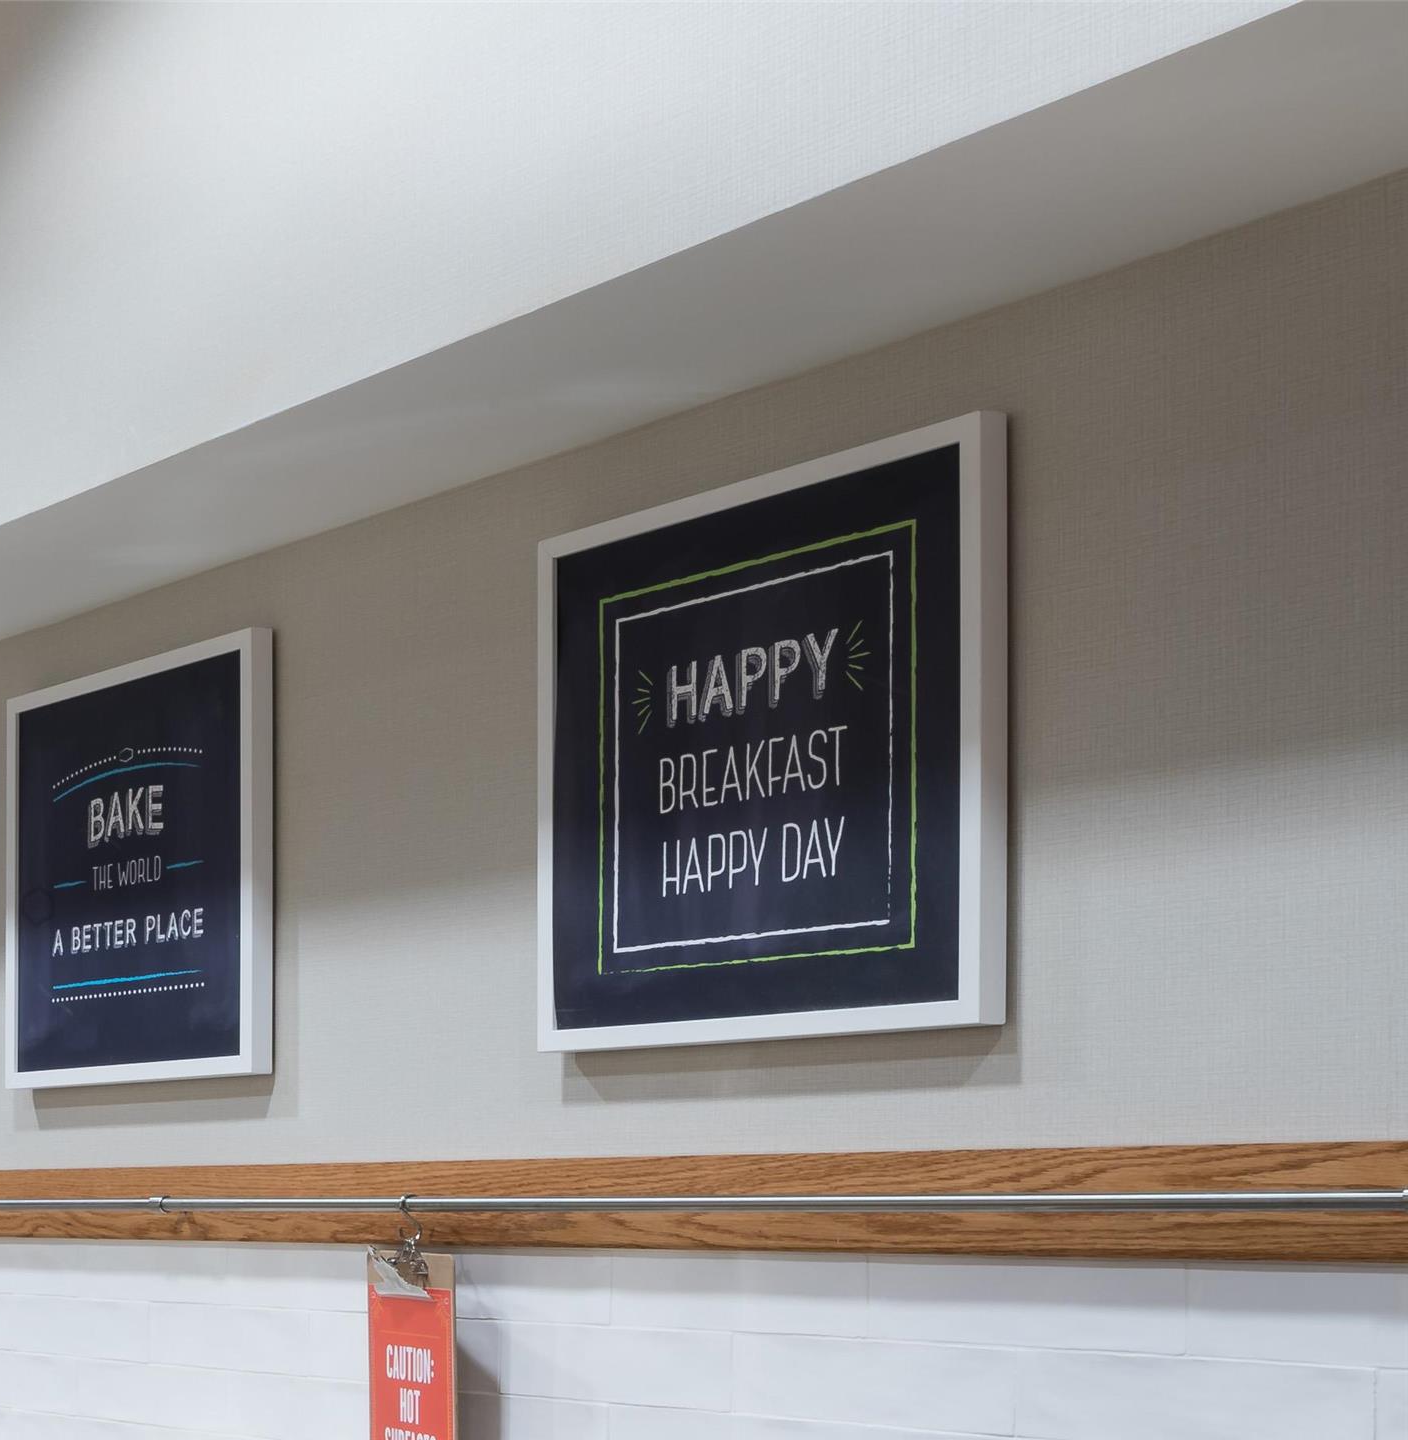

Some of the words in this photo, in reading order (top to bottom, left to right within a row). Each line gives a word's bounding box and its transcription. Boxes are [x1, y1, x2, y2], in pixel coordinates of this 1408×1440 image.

[666, 627, 839, 728] HAPPY
[660, 725, 848, 815] BREAKFAST
[87, 784, 164, 849] BAKE
[92, 864, 112, 891] THE
[118, 855, 161, 885] WORLD
[662, 827, 768, 898] HAPPY
[782, 816, 845, 882] DAY
[52, 929, 64, 957] A
[71, 919, 137, 954] BETTER
[145, 908, 204, 944] PLACE
[387, 1344, 434, 1384] CAUTION:
[400, 1388, 420, 1425] HOT
